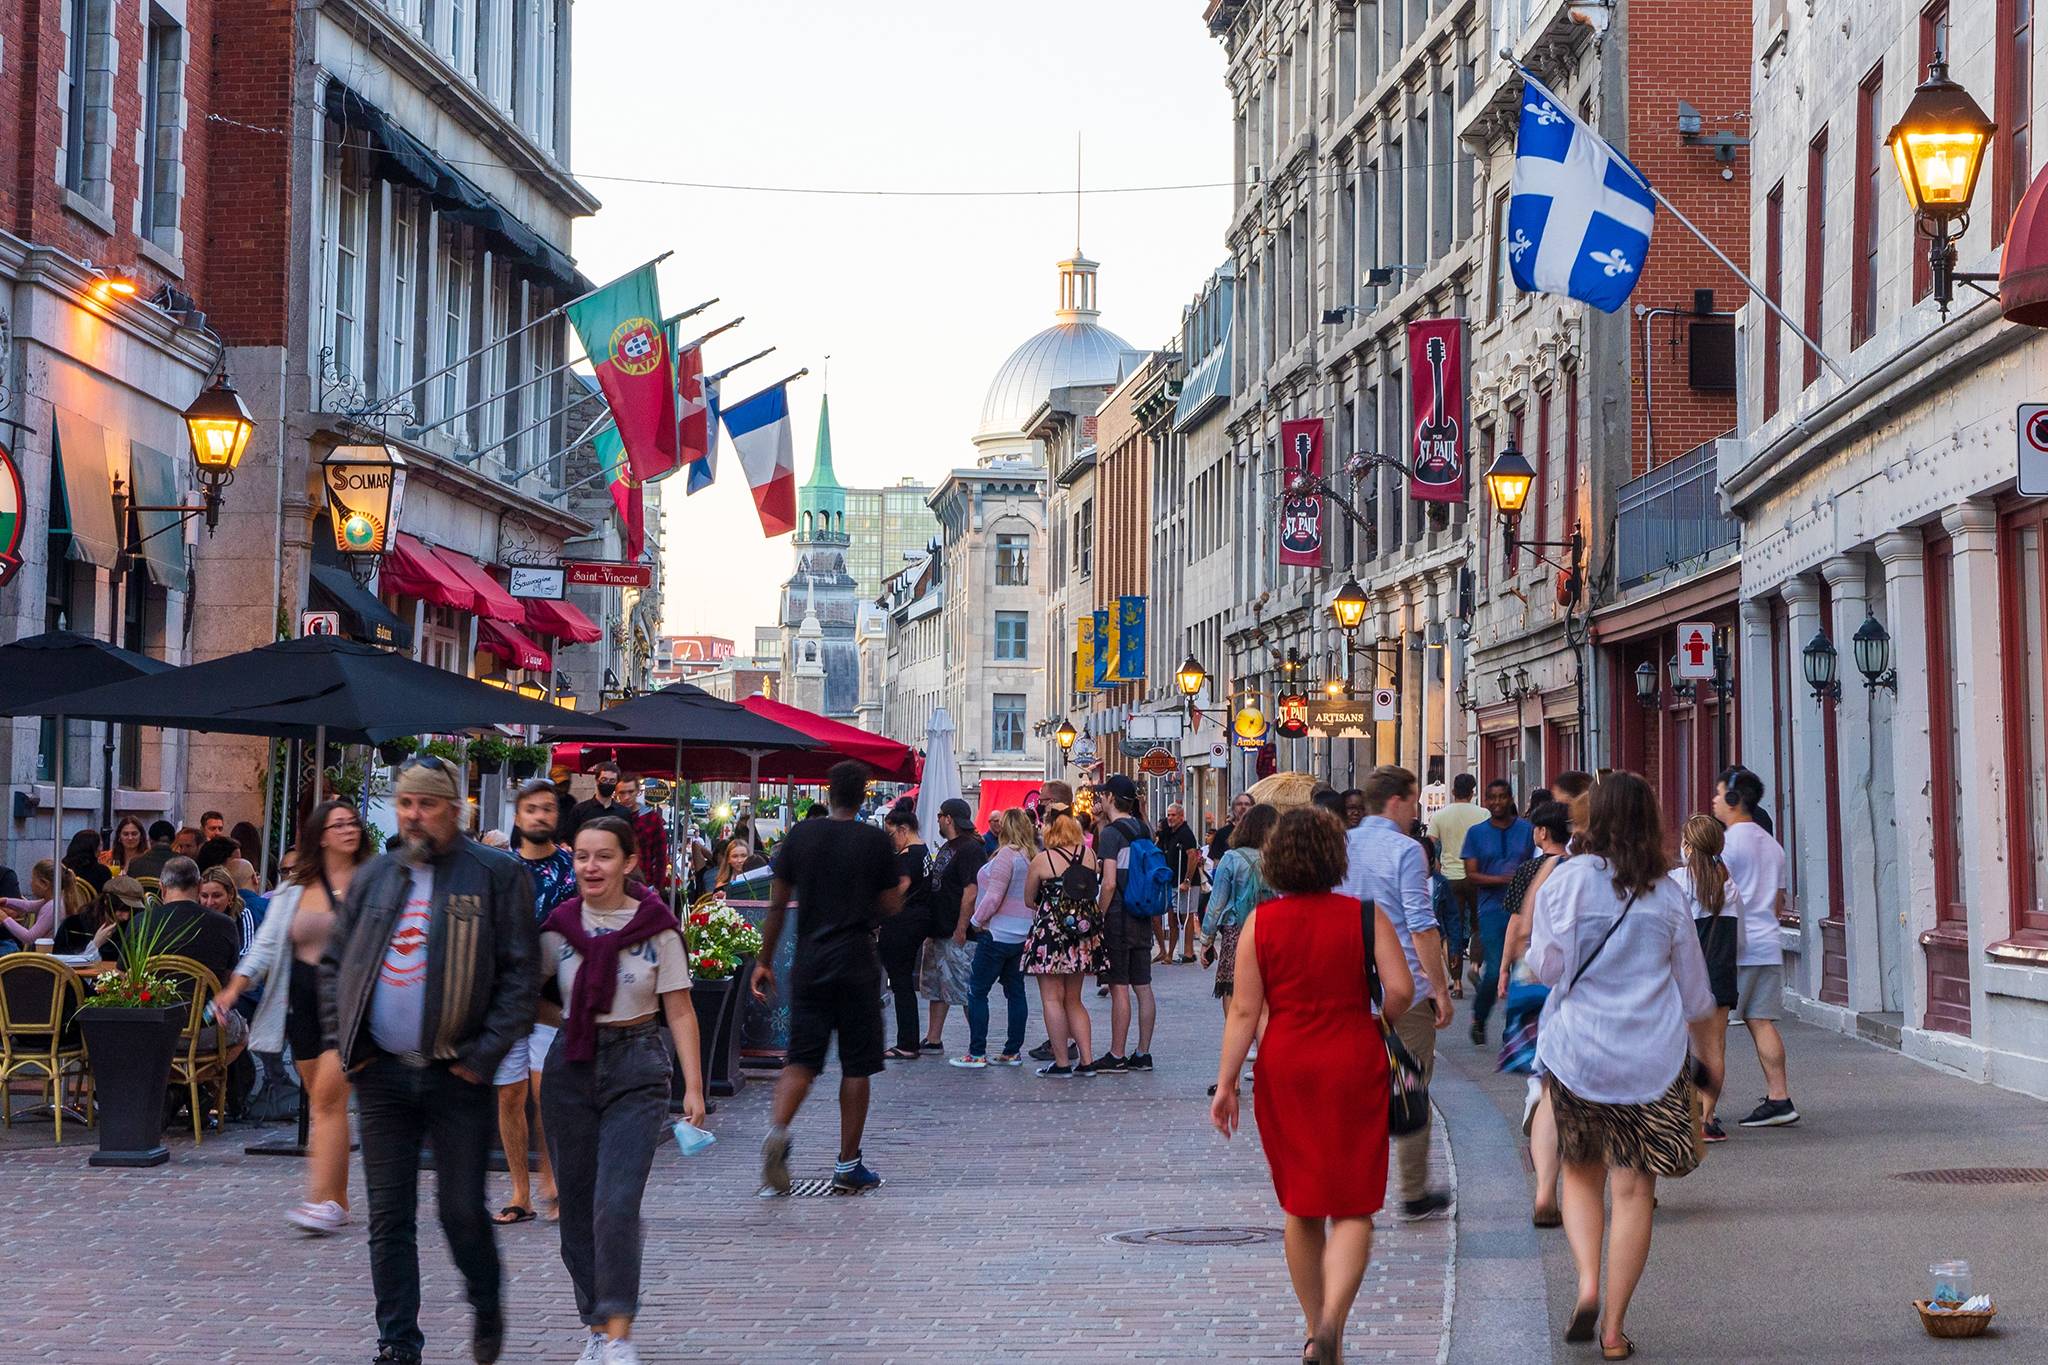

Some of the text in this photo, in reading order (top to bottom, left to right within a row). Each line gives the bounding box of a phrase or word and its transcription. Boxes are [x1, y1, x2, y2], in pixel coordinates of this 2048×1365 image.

[1418, 440, 1458, 470] ST. PAUL
[332, 465, 390, 490] SOLMAR
[1284, 517, 1318, 541] ST. PAUL
[573, 570, 639, 584] Saint-Vincent
[1277, 706, 1309, 728] ST. PAUL
[1315, 713, 1364, 722] ARTISANS
[1236, 736, 1265, 747] Amber
